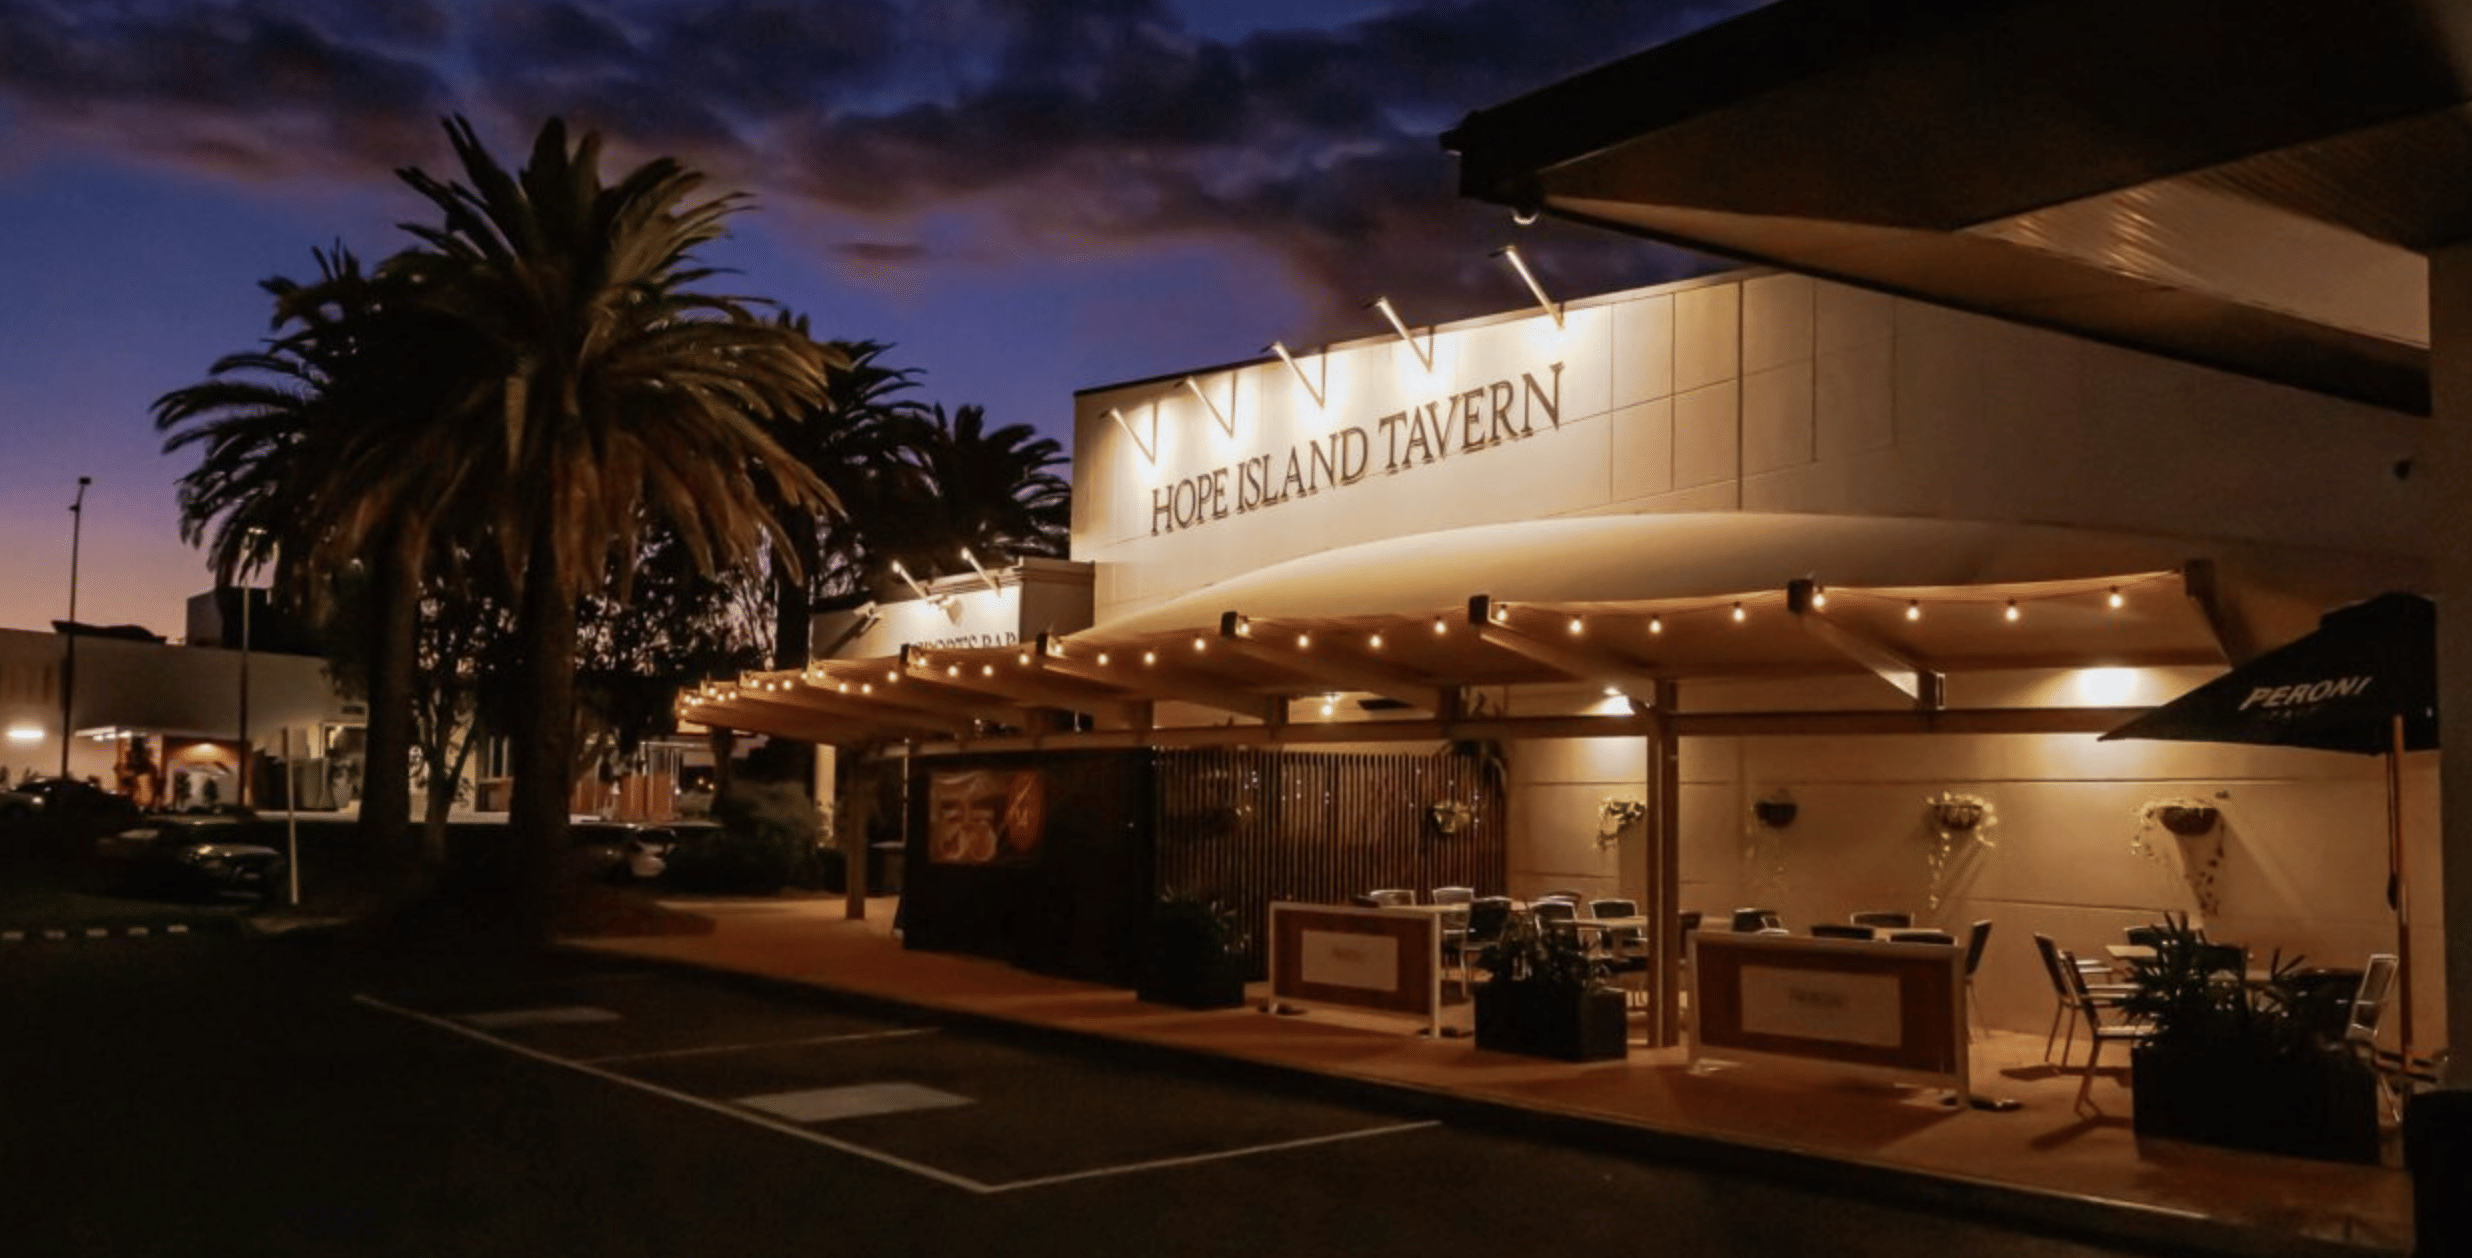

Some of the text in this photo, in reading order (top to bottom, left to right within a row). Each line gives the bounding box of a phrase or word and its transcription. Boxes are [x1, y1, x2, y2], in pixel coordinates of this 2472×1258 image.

[1151, 361, 1565, 536] HOPE ISLAND TAVERN
[2238, 675, 2374, 711] PERONI
